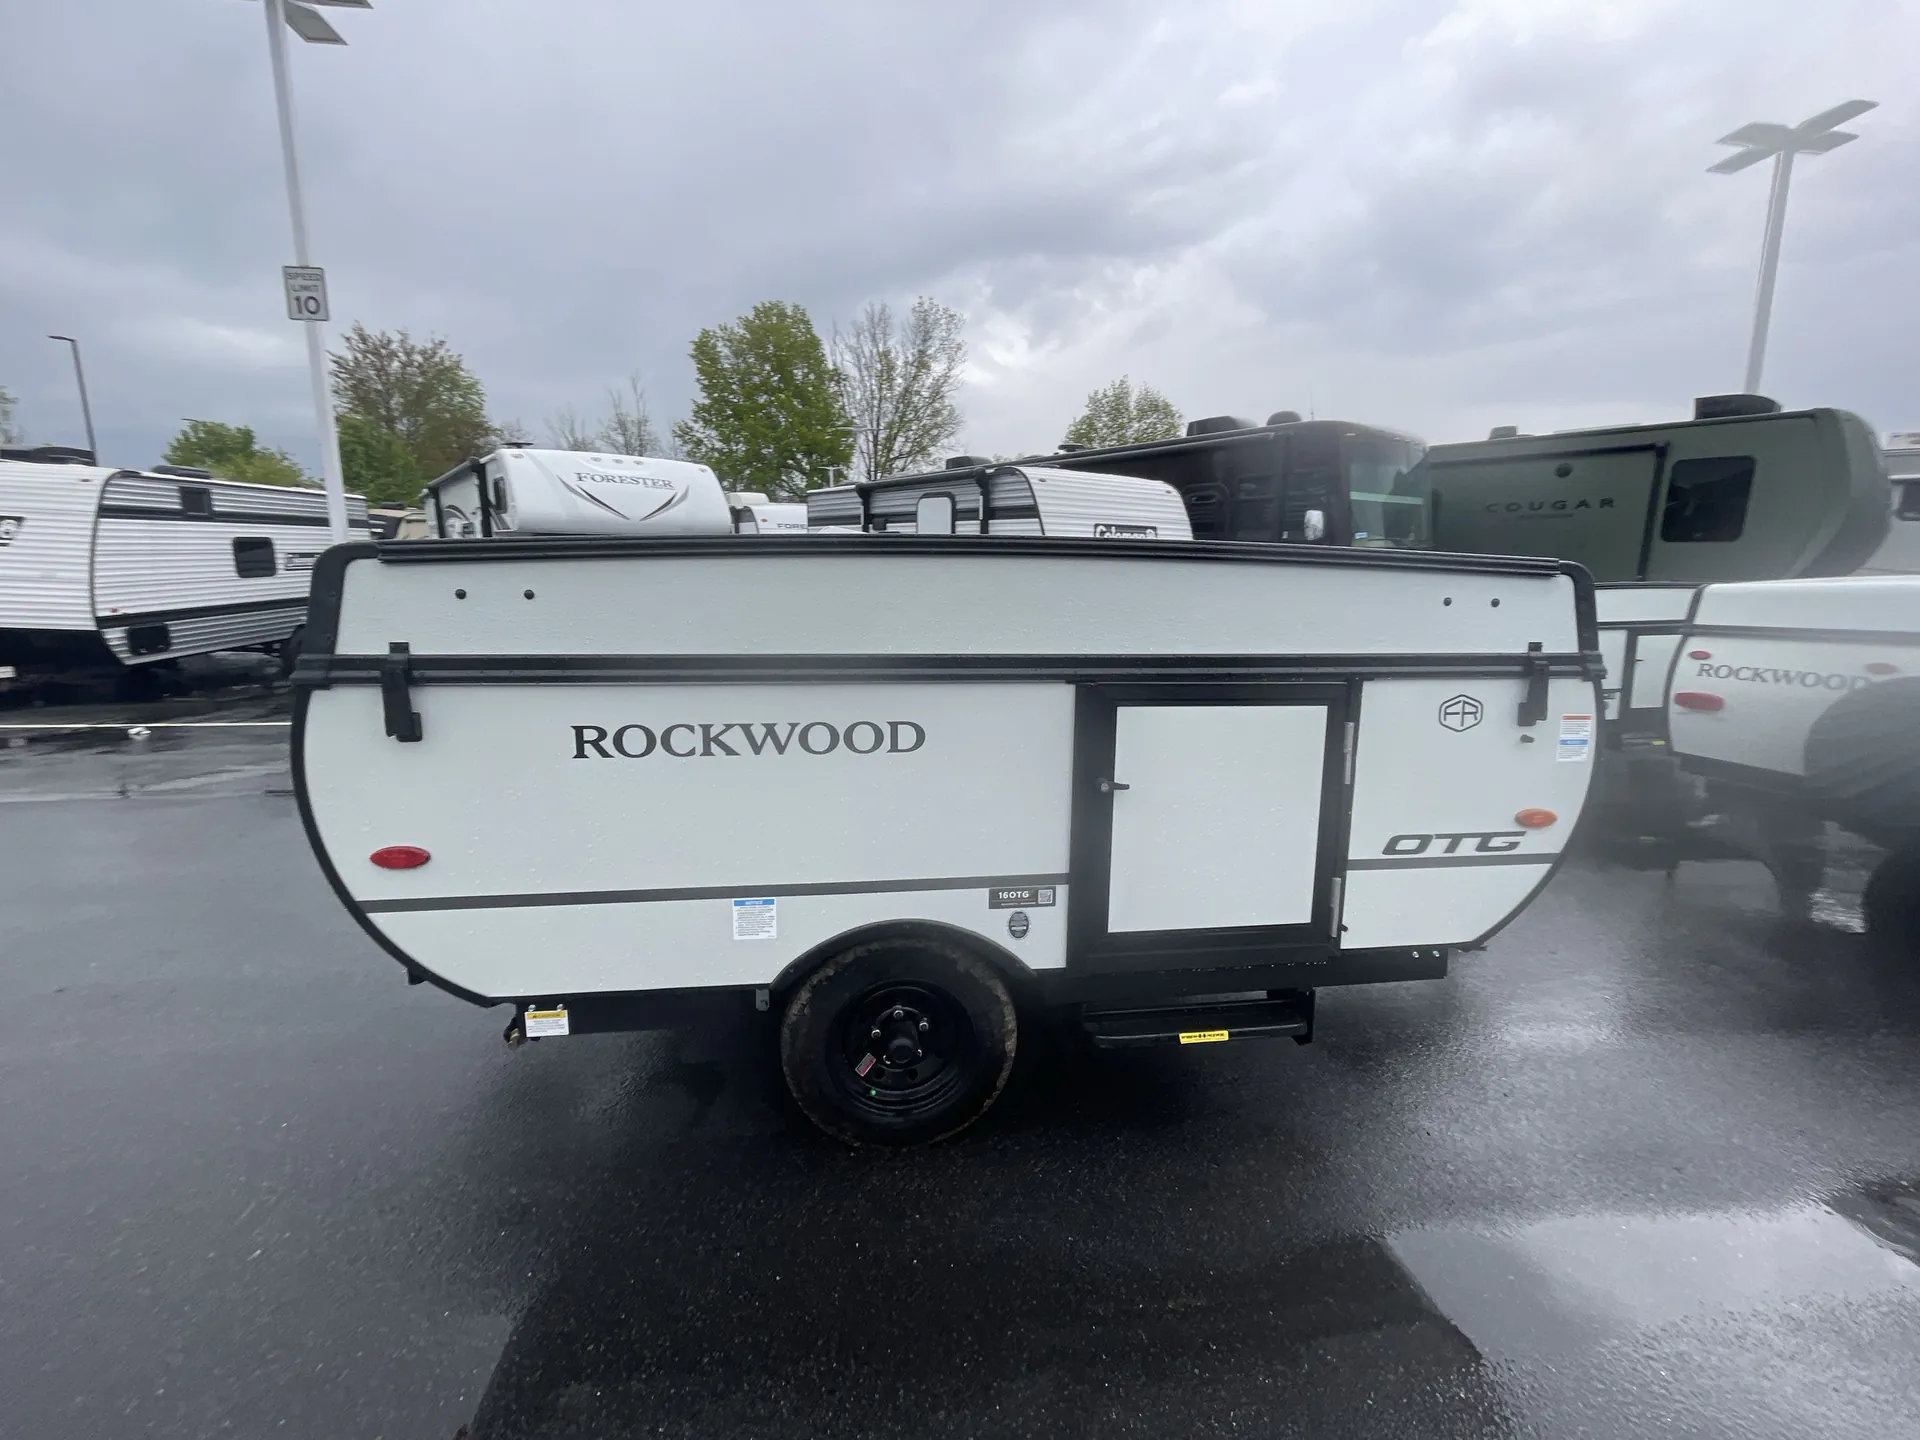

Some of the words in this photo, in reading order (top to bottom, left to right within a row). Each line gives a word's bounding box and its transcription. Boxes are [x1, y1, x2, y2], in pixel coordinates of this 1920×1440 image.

[294, 295, 321, 315] 10
[574, 472, 675, 489] FORESTER
[1486, 498, 1615, 513] COUGAR
[570, 721, 926, 759] ROCKWOOD
[1381, 830, 1528, 856] OTG
[998, 891, 1029, 899] 16OTG
